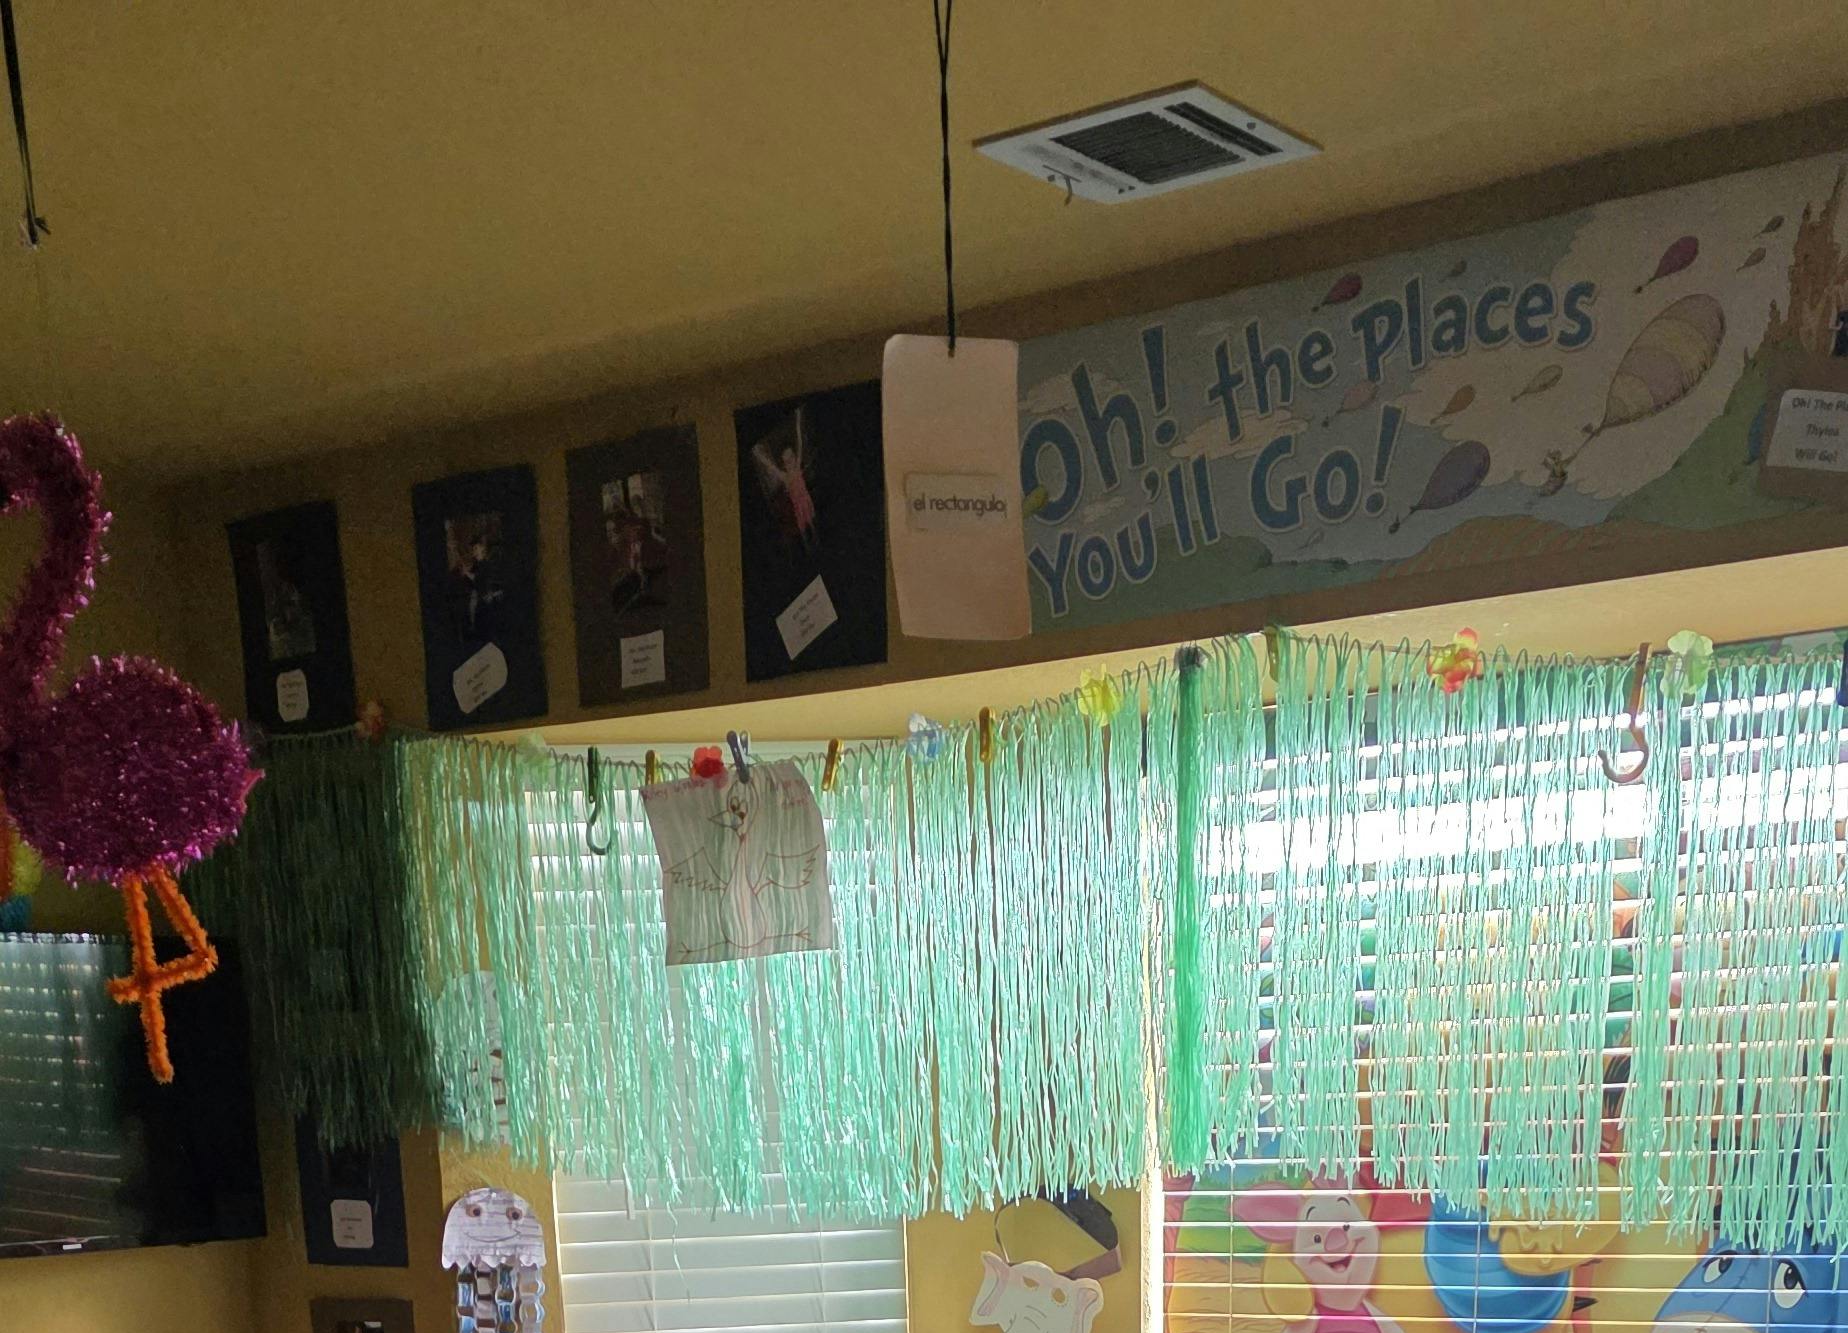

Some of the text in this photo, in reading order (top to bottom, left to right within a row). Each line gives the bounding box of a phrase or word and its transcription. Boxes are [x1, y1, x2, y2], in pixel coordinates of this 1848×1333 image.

[913, 492, 926, 511] el
[1020, 275, 1597, 522] Oh! the Places
[1027, 404, 1401, 616] You'll Go!
